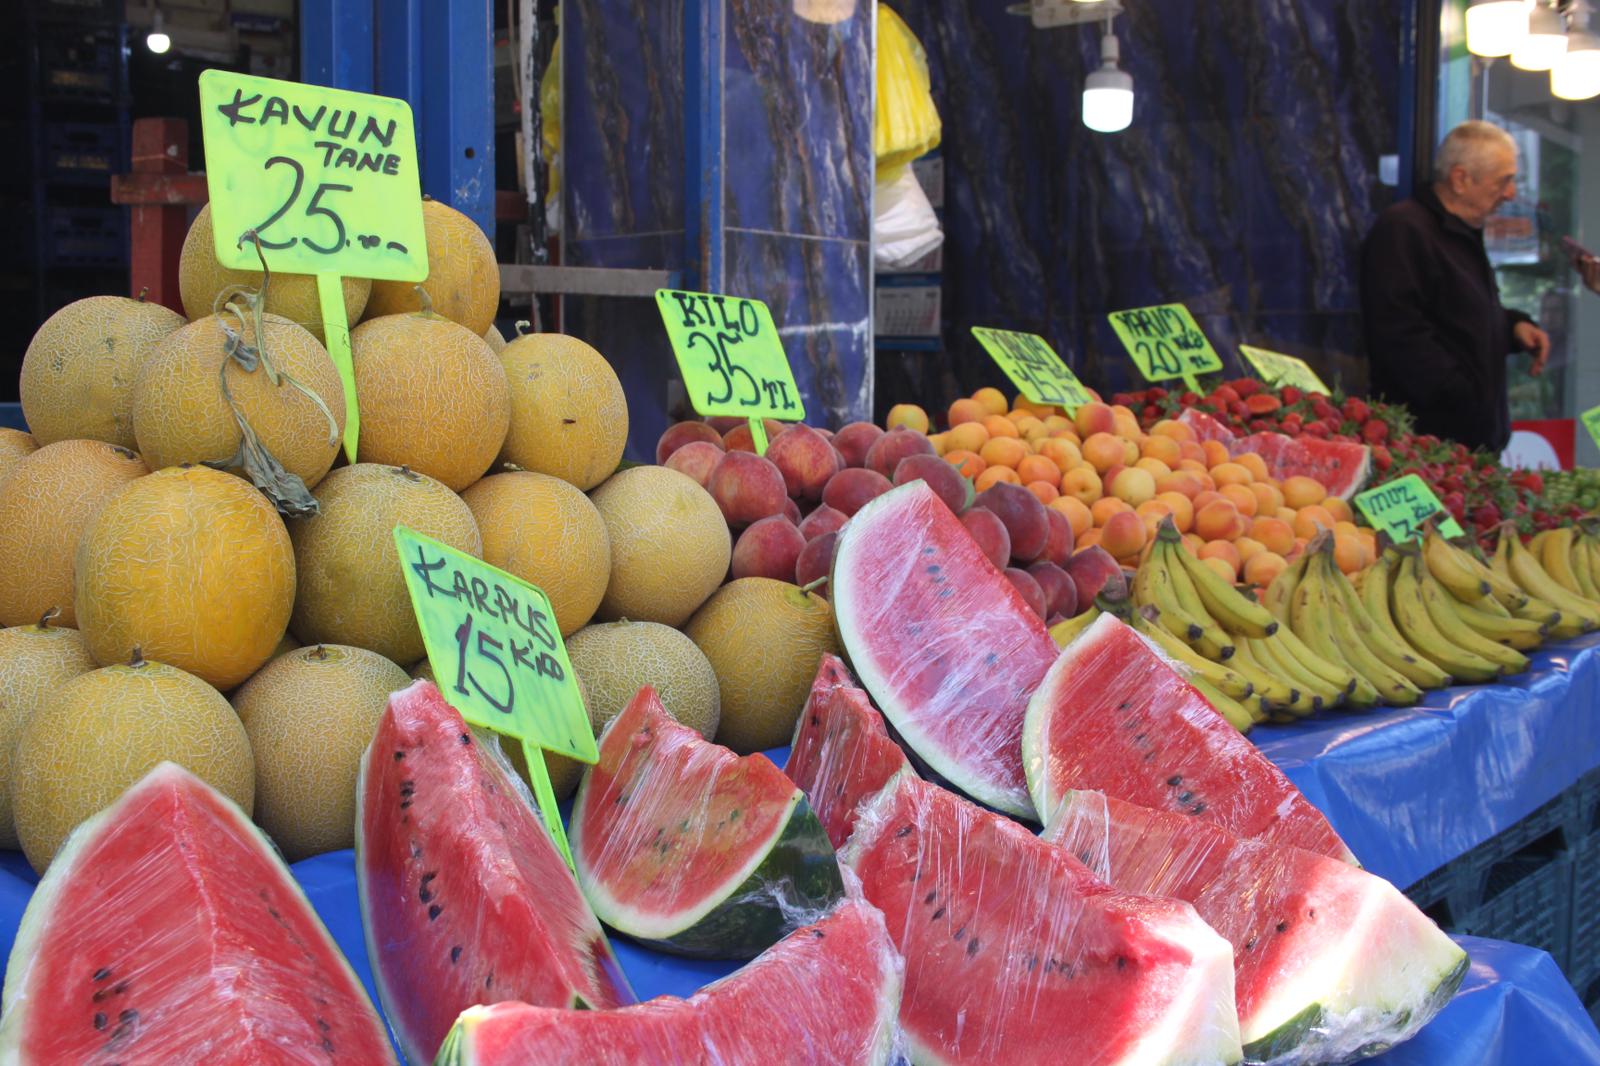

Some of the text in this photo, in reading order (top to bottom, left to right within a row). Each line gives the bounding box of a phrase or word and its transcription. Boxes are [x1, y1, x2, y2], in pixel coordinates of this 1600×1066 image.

[217, 88, 397, 147] KAVUN
[314, 141, 401, 175] TANE
[671, 291, 759, 337] KILO
[688, 332, 796, 410] 35 TL
[1135, 340, 1183, 376] 20
[410, 545, 557, 651] KARPUS
[453, 613, 515, 714] 15
